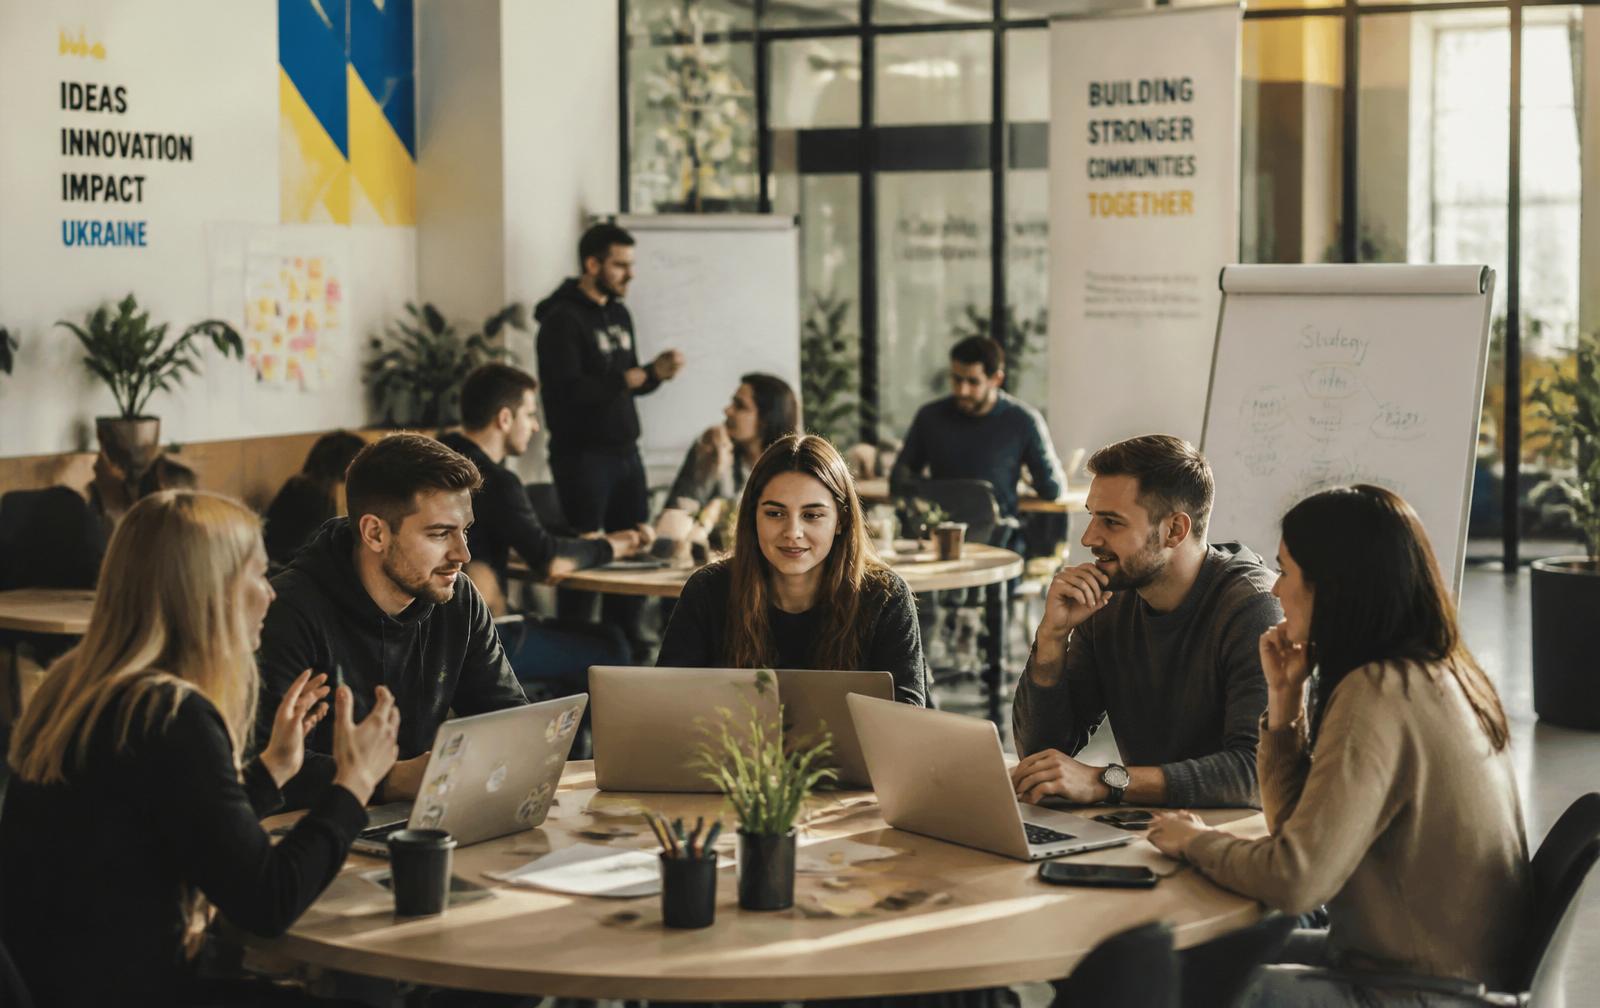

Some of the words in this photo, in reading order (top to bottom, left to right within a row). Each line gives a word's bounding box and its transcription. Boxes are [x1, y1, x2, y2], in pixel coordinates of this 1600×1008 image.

[61, 82, 128, 114] IDEAS
[1088, 77, 1193, 107] BUILDING
[61, 128, 193, 161] INNOVATION
[1088, 117, 1194, 145] STRONGER
[1087, 155, 1196, 179] COMMUNITIES
[62, 173, 145, 203] IMPACT
[1087, 190, 1194, 219] TOGETHER
[62, 220, 147, 247] UKRAINE
